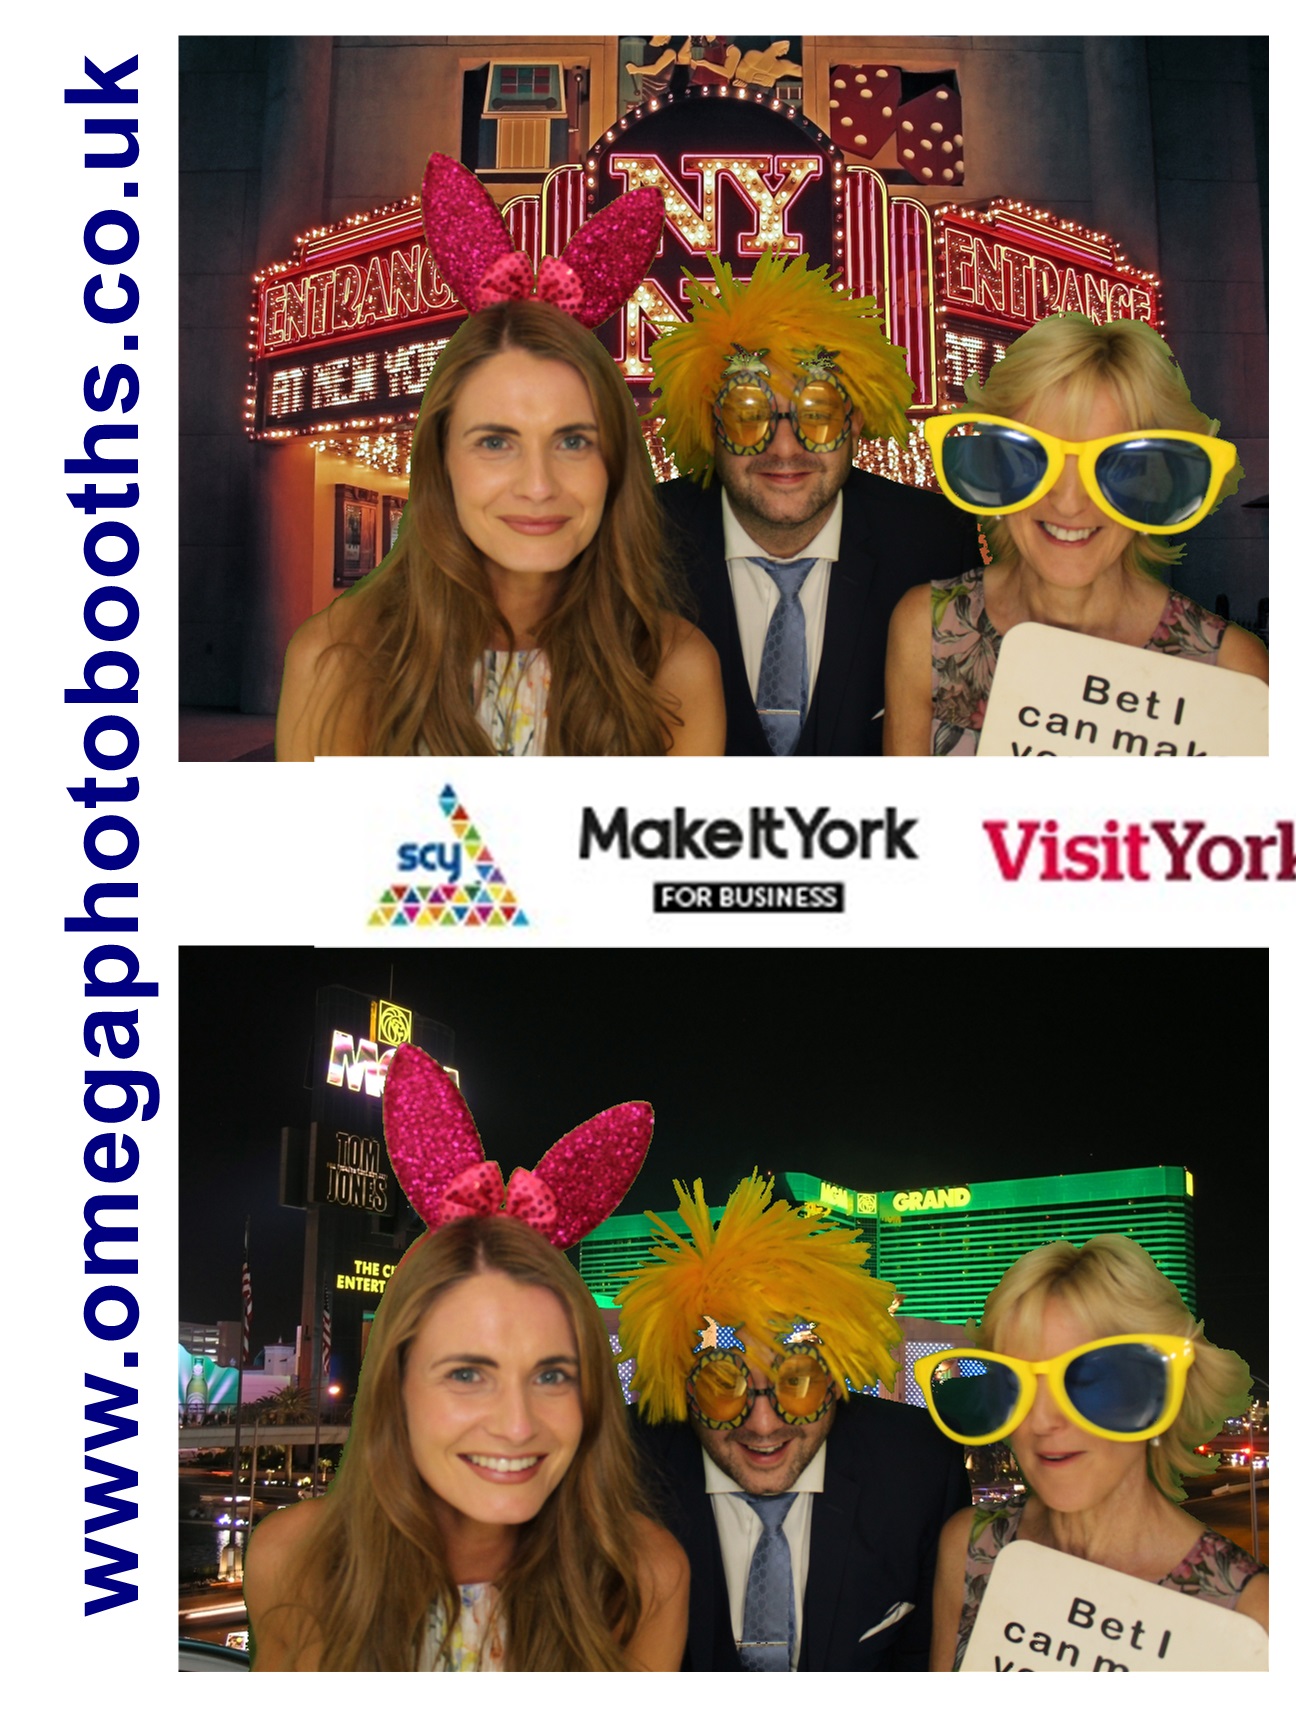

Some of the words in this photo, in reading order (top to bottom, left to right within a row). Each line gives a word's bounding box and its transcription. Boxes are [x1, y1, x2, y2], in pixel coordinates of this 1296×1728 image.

[609, 154, 823, 256] NY
[263, 244, 459, 347] ENTRANC
[1082, 675, 1160, 719] Bet
[1174, 697, 1185, 725] I
[1018, 706, 1098, 743] can
[335, 1131, 380, 1173] TOM
[326, 1168, 388, 1213] JONES
[893, 1187, 971, 1212] GRAND
[354, 1259, 380, 1276] THE
[1004, 1621, 1080, 1667] can
[1068, 1597, 1145, 1650] Bet
[1158, 1630, 1171, 1659] I
